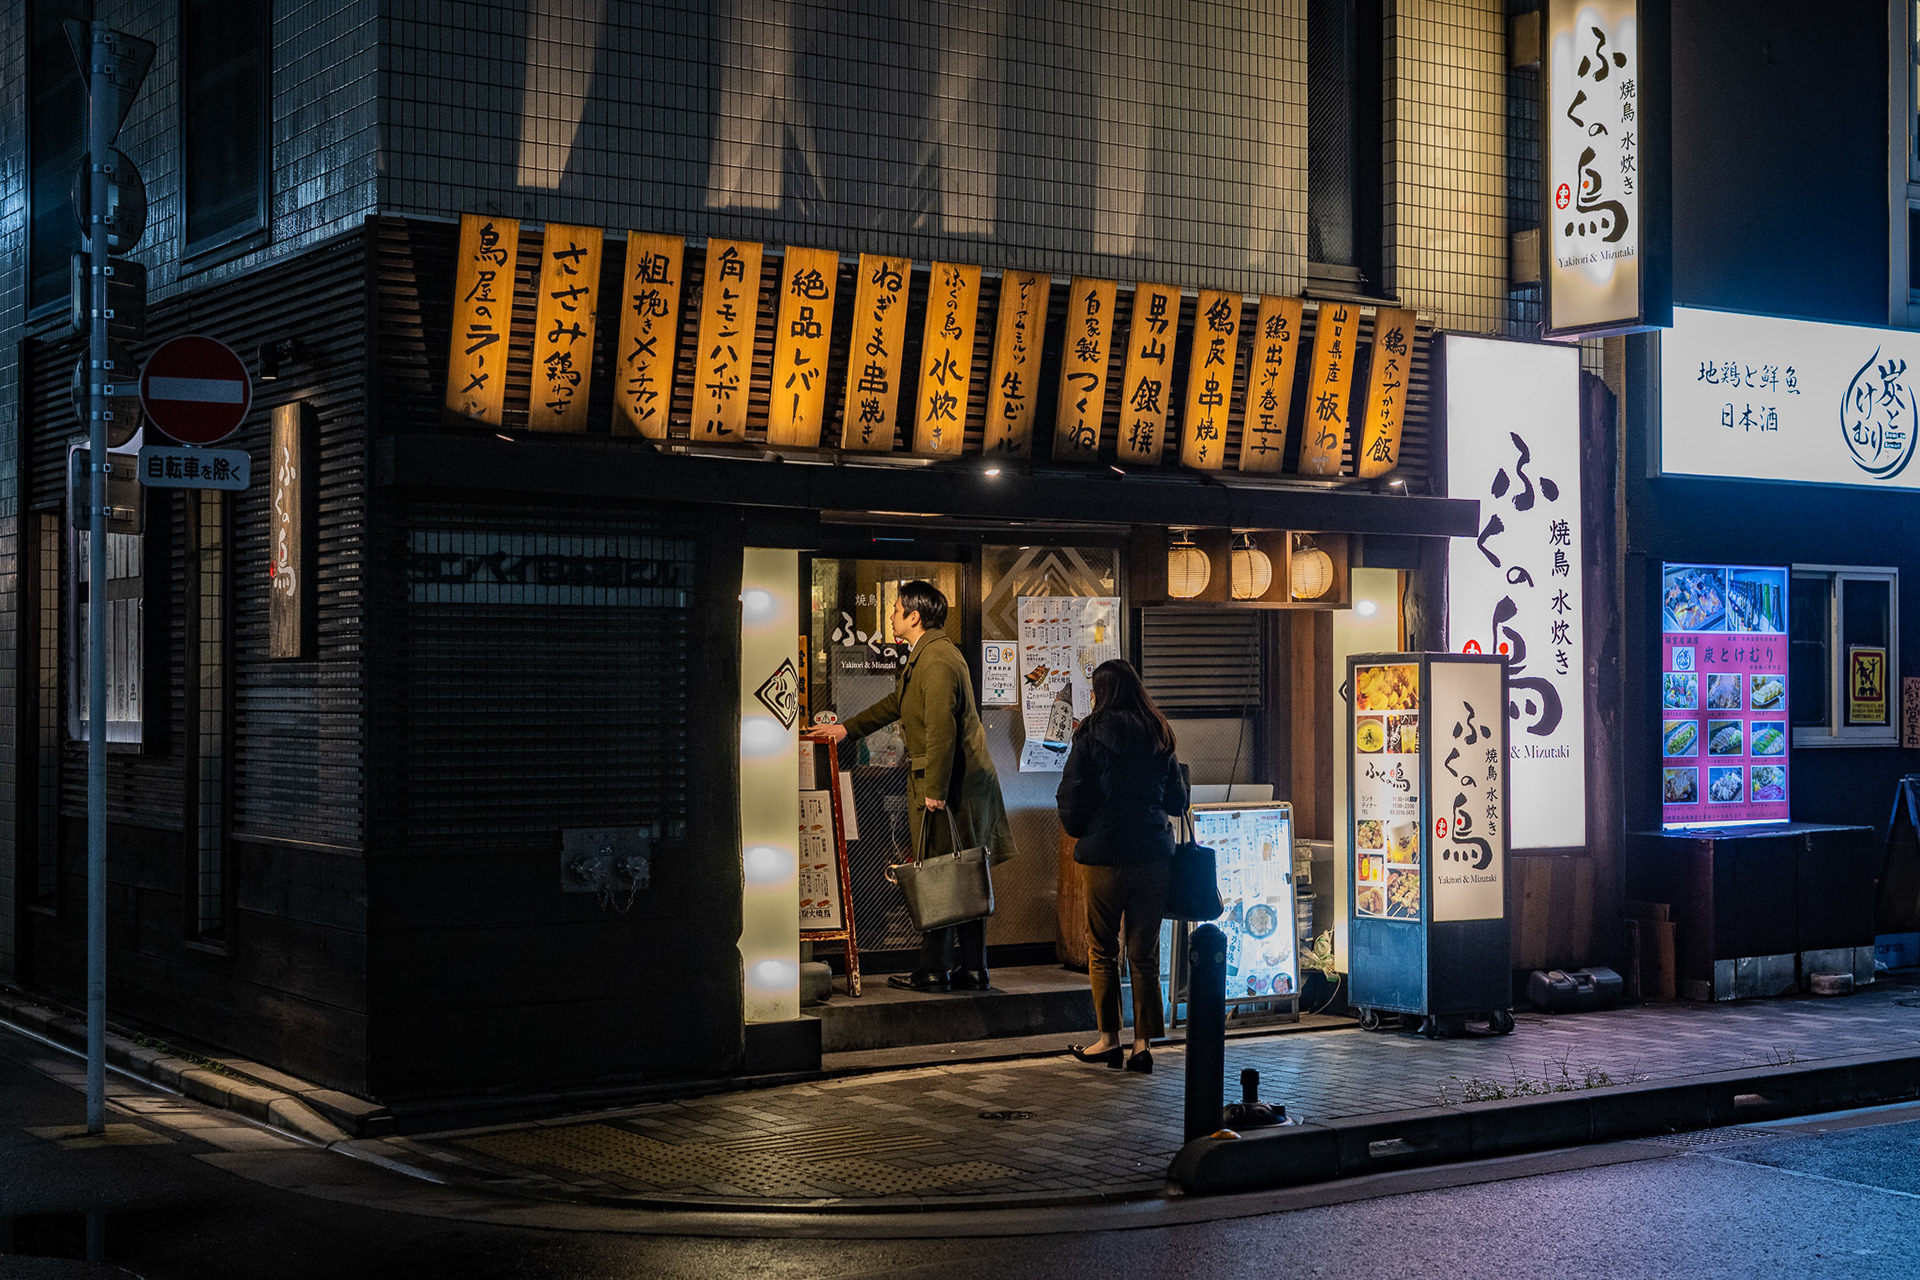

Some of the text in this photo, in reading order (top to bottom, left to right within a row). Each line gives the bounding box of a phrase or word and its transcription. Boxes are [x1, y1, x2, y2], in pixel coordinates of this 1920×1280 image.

[1564, 26, 1629, 243] ふくの鳥
[1619, 79, 1636, 195] 焼鳥 水炊き
[461, 222, 507, 420] 鳥屋のラーメン
[1558, 245, 1634, 269] Yakitori & Mizutaki
[543, 242, 590, 415] ささみ鶏わさ
[626, 251, 675, 421] 粗挽きメンチカツ
[705, 246, 745, 436] 角レモンハイボール
[785, 268, 829, 425] 絶品レバー
[857, 262, 903, 445] ねぎま串焼き
[1194, 297, 1235, 463] 鶏皮串焼き
[1250, 313, 1290, 455] 鶏出汁巻玉子
[1365, 327, 1407, 465] 鶏スープかけご飯
[1697, 360, 1801, 395] 地鶏と鮮魚
[147, 454, 242, 483] 自転車を除く
[1721, 402, 1778, 432] 日本酒
[273, 447, 297, 596] ふくの鳥
[832, 611, 908, 665] ふくの
[841, 661, 863, 669] Yakitori
[872, 661, 896, 669] Mizutaki
[1548, 519, 1573, 675] 焼鳥 水炊き
[1704, 646, 1774, 663] 炭とけむり
[1366, 762, 1410, 792] ふくの鳥
[1443, 701, 1492, 870] ふくの鳥
[1485, 748, 1499, 836] 焼鳥 水炊き
[1510, 744, 1570, 759] & Mizutaki
[1438, 874, 1497, 885] Yakitori & Mizutaki
